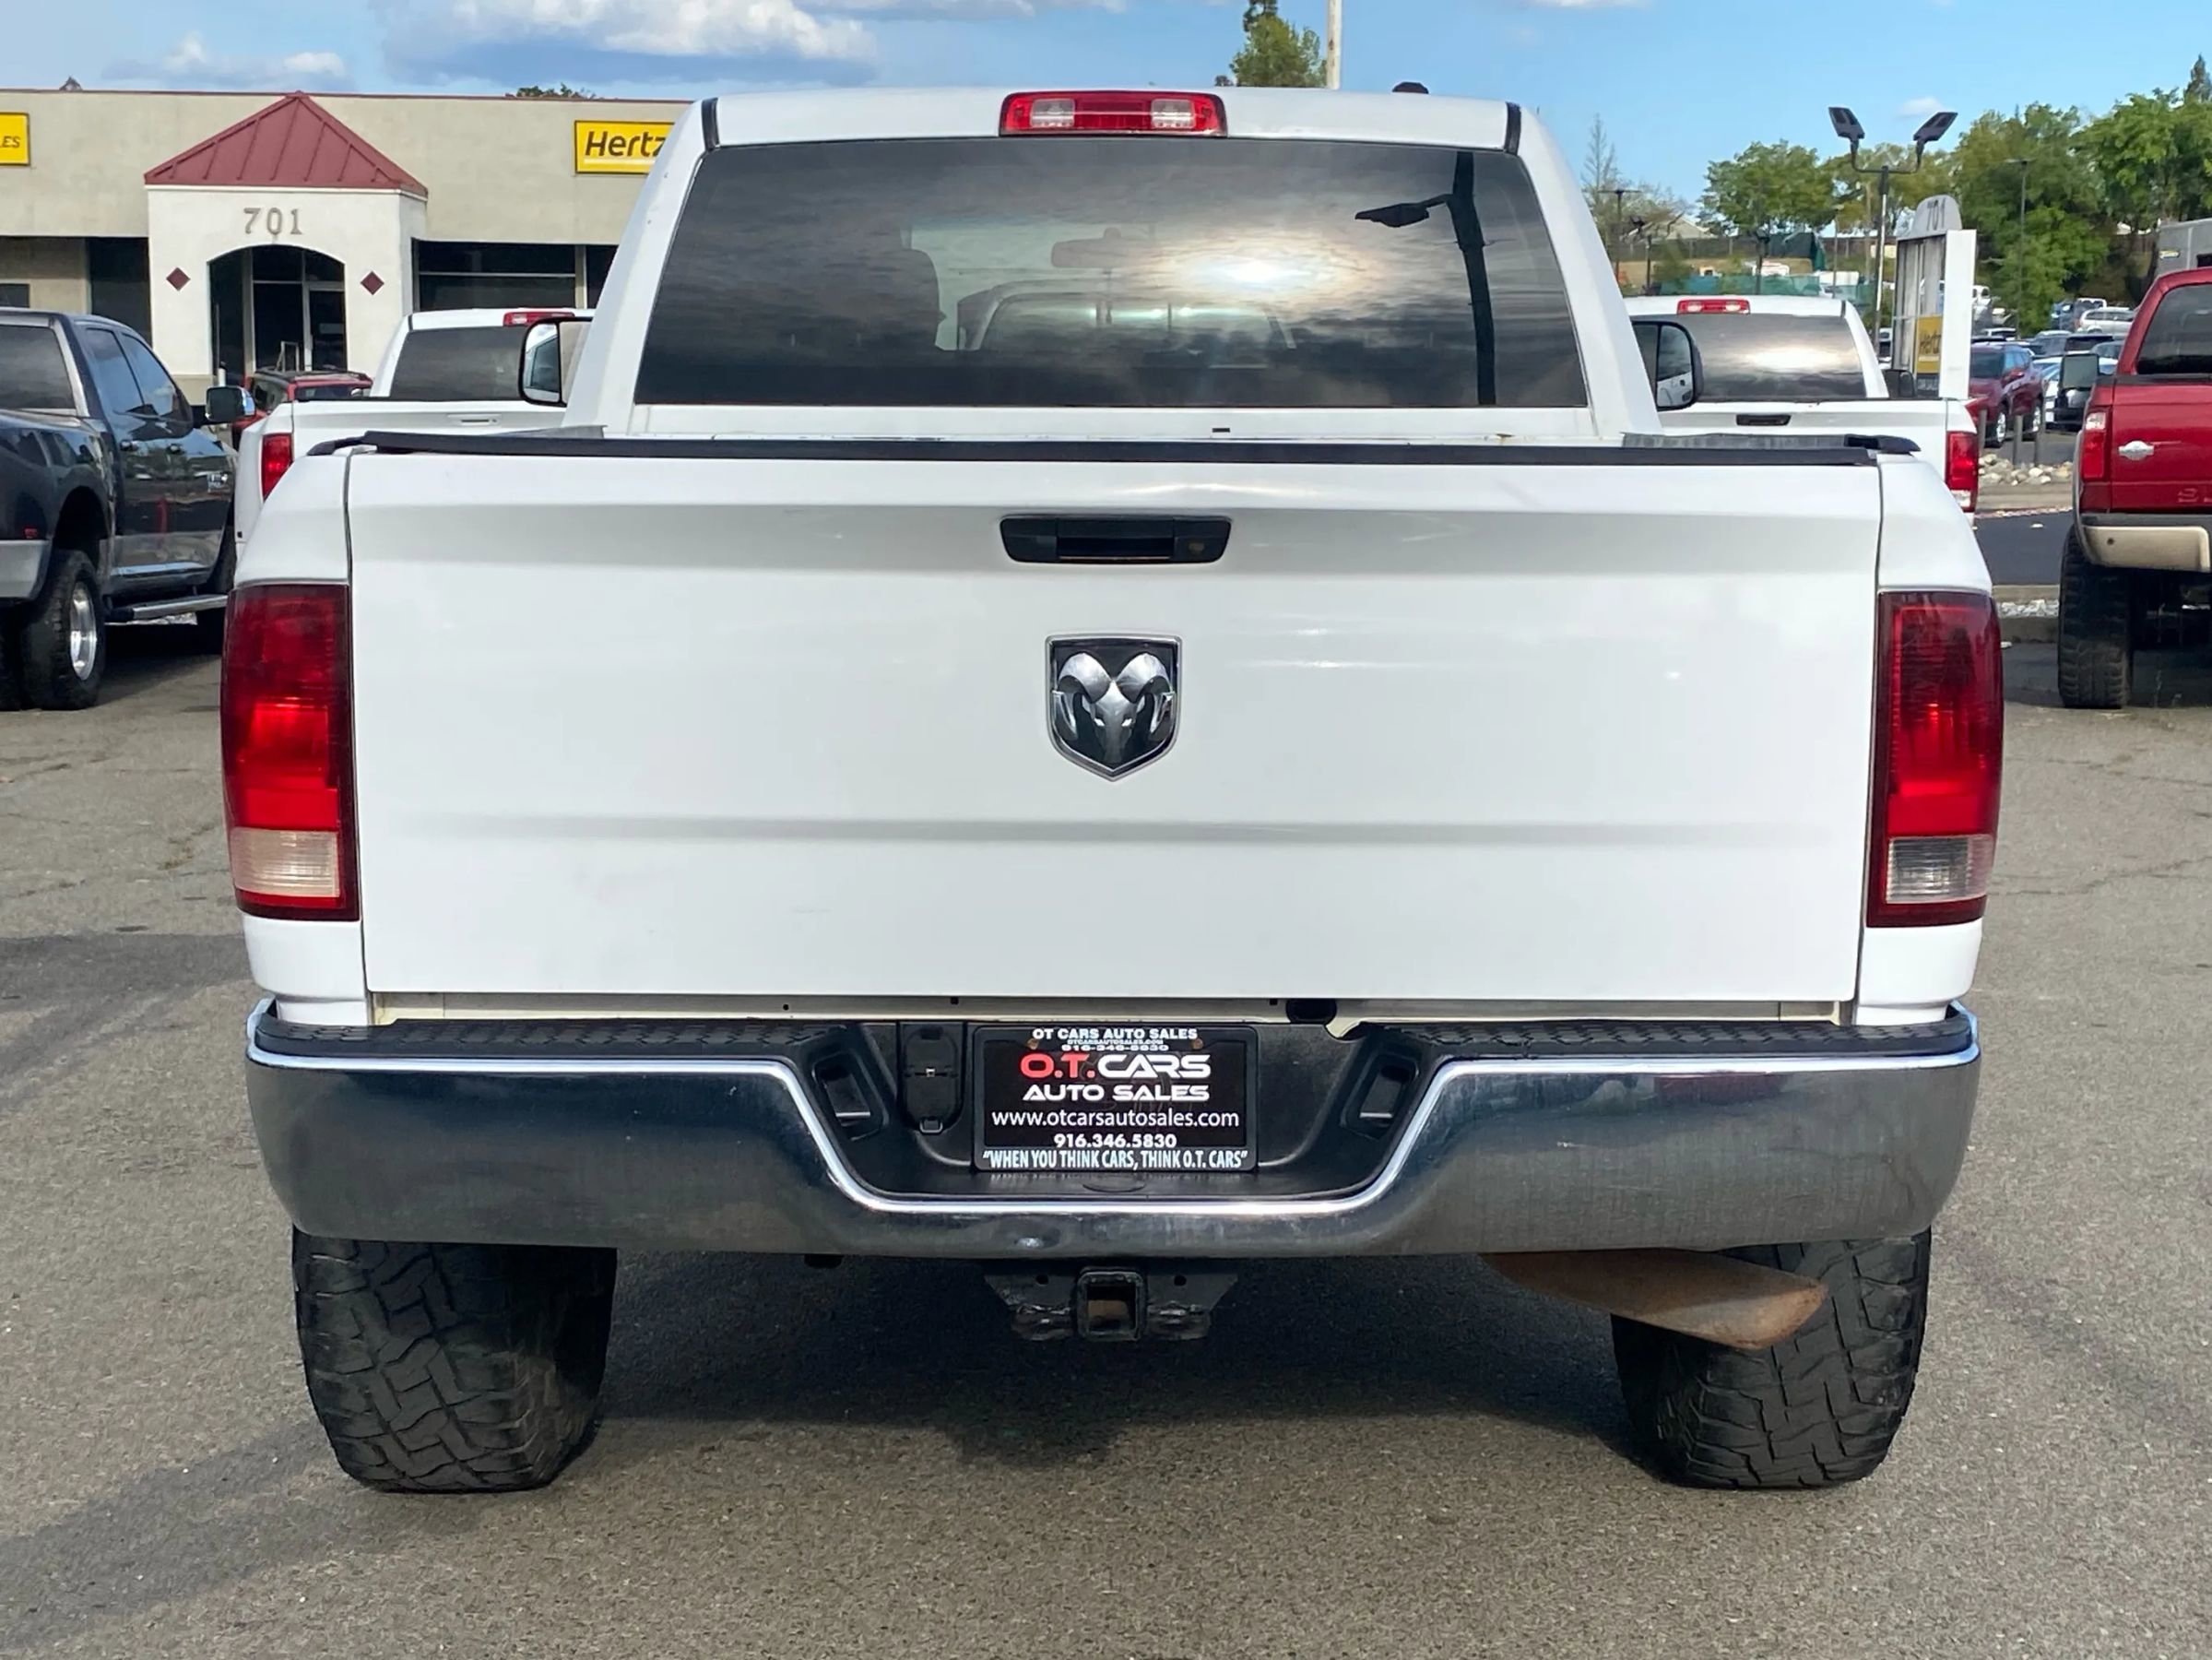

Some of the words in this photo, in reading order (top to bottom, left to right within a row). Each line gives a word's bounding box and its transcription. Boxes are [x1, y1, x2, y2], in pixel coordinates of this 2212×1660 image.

[585, 131, 666, 157] Hertz
[243, 208, 302, 235] 701
[1926, 197, 1946, 231] 701
[1032, 1028, 1054, 1039] OT
[1058, 1028, 1100, 1039] CARS
[1103, 1028, 1145, 1039] AUTO
[1149, 1028, 1198, 1039] SALES
[1023, 1085, 1105, 1101] AUTO
[1112, 1085, 1210, 1101] SALES
[991, 1108, 1239, 1126] www.otcarsautosales.com
[1054, 1133, 1177, 1148] 916.346.5830
[1031, 1150, 1058, 1168] YOU
[1059, 1150, 1100, 1168] THINK
[1102, 1150, 1139, 1170] CARS,
[1141, 1150, 1181, 1168] THINK
[1183, 1150, 1206, 1168] O.T.
